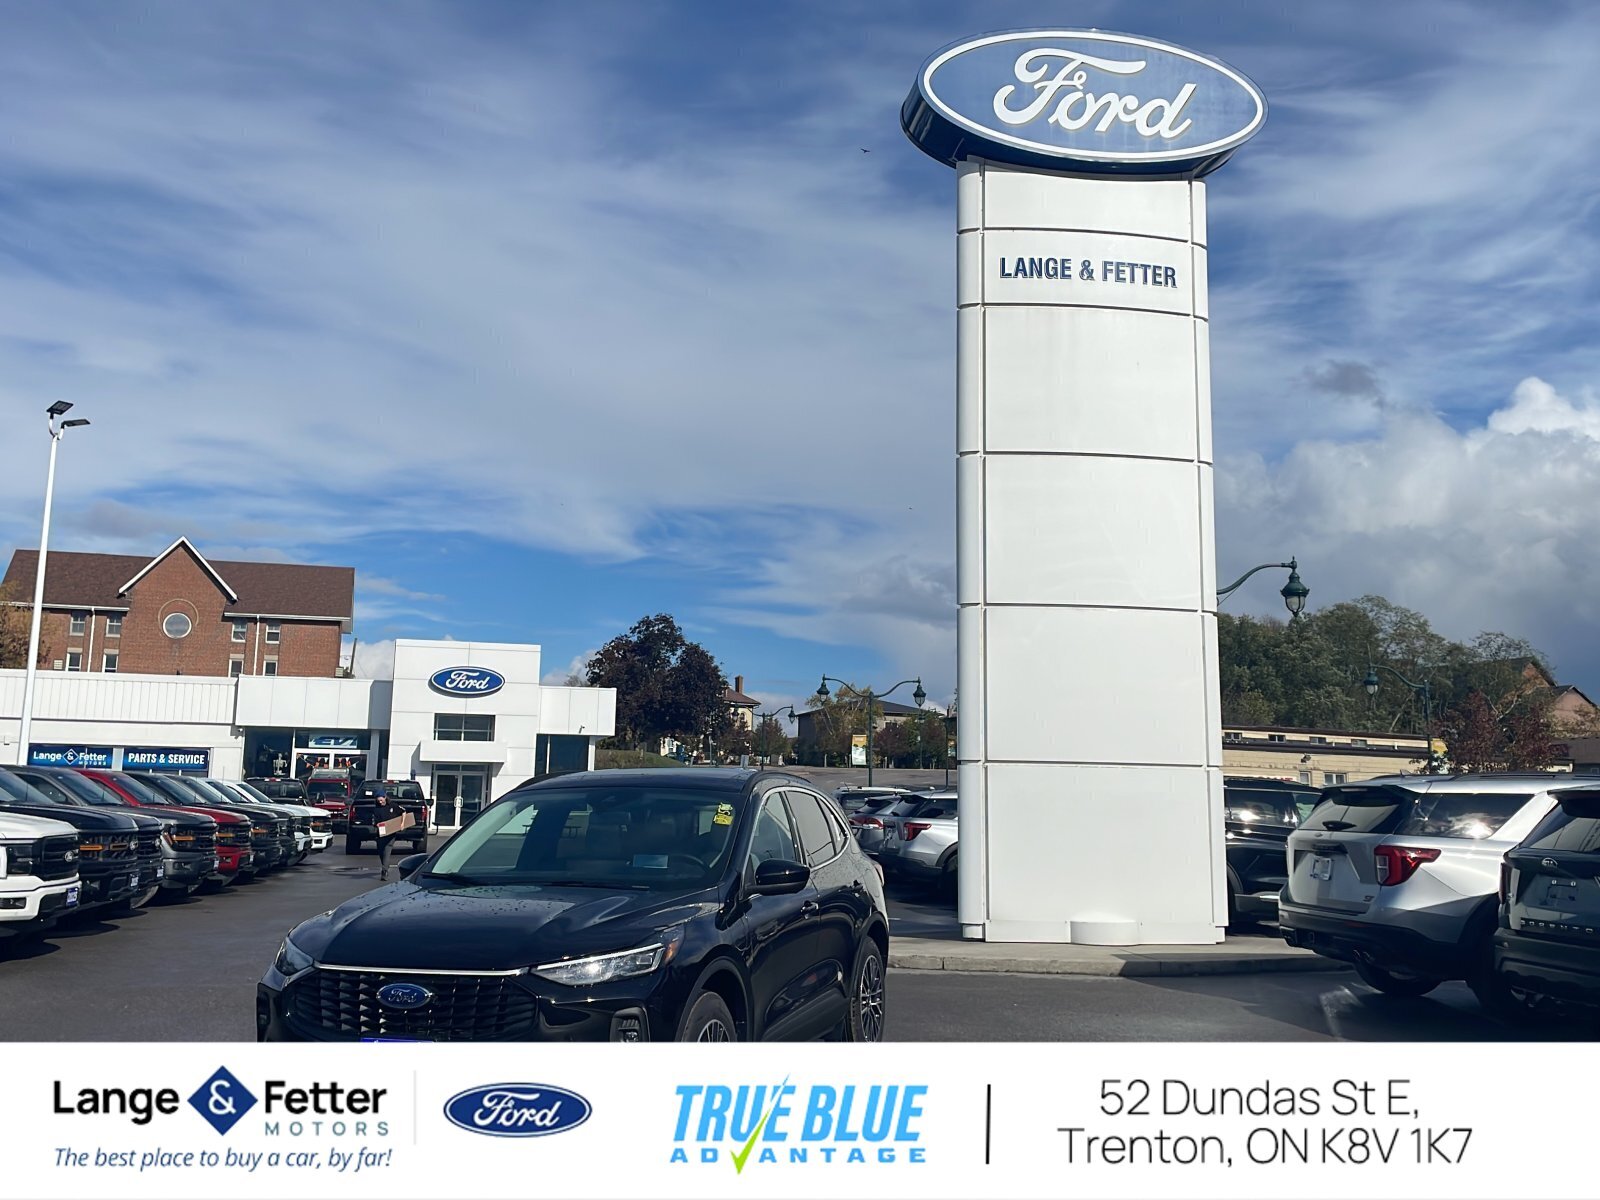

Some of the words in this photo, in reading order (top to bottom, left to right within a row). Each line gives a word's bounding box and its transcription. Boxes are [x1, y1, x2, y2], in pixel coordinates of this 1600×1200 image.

[993, 48, 1197, 138] Ford
[1000, 257, 1072, 280] LANGE
[1079, 259, 1095, 281] &
[1102, 260, 1178, 288] FETTER
[445, 670, 491, 690] Ford
[33, 751, 62, 761] Lange
[66, 752, 75, 761] &
[79, 752, 107, 761] Fetter
[128, 753, 157, 763] PARTS
[158, 754, 165, 763] &
[168, 754, 205, 765] SERVICE
[388, 988, 417, 1003] Ford
